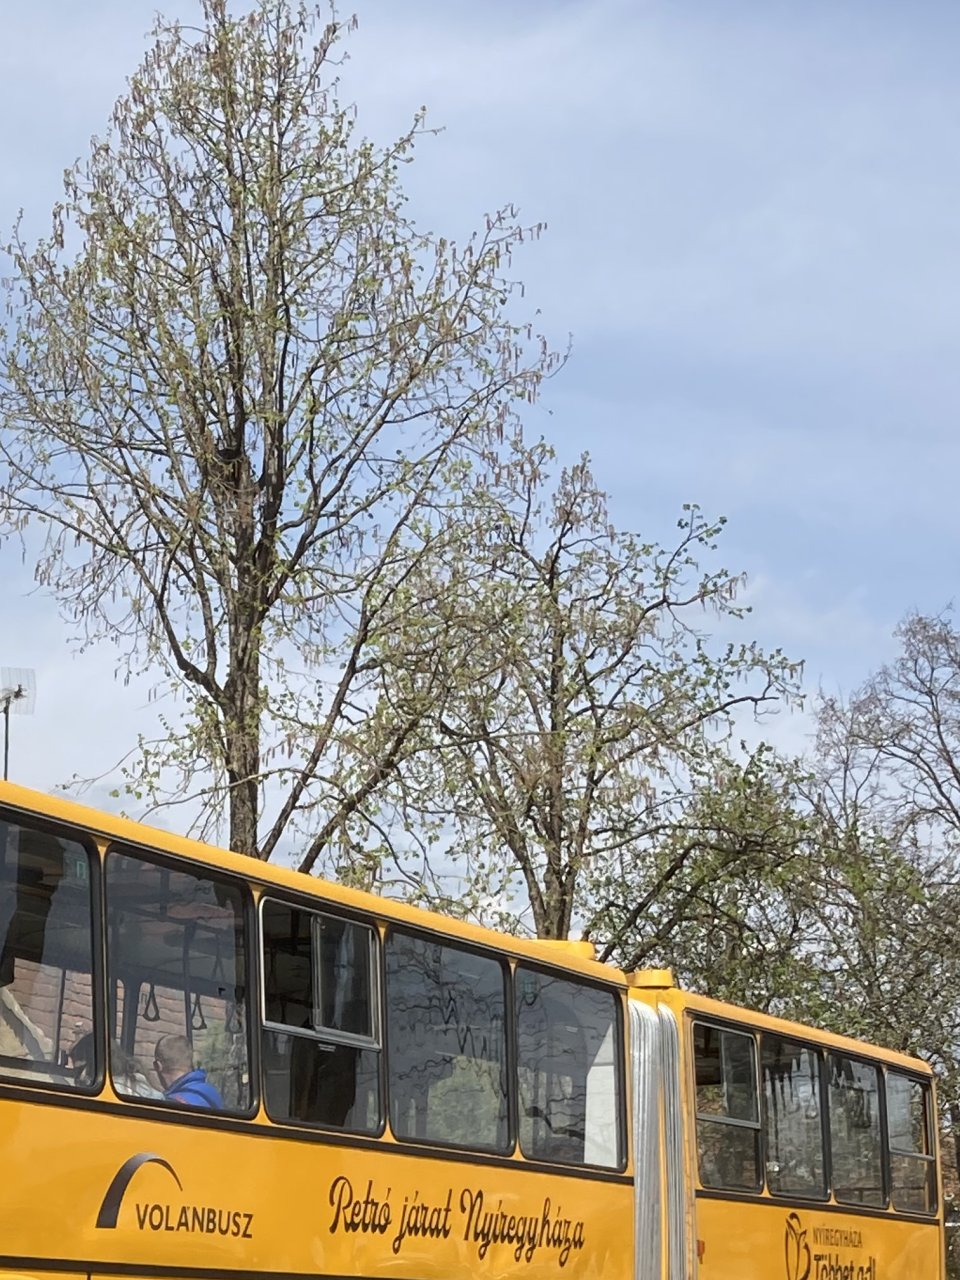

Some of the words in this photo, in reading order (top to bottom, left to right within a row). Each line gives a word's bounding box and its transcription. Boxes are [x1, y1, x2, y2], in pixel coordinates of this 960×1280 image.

[135, 1203, 254, 1239] VOLÁNBUSZ
[328, 1175, 392, 1235] Retró
[392, 1188, 453, 1255] járat
[460, 1188, 585, 1267] Nyíregyháza
